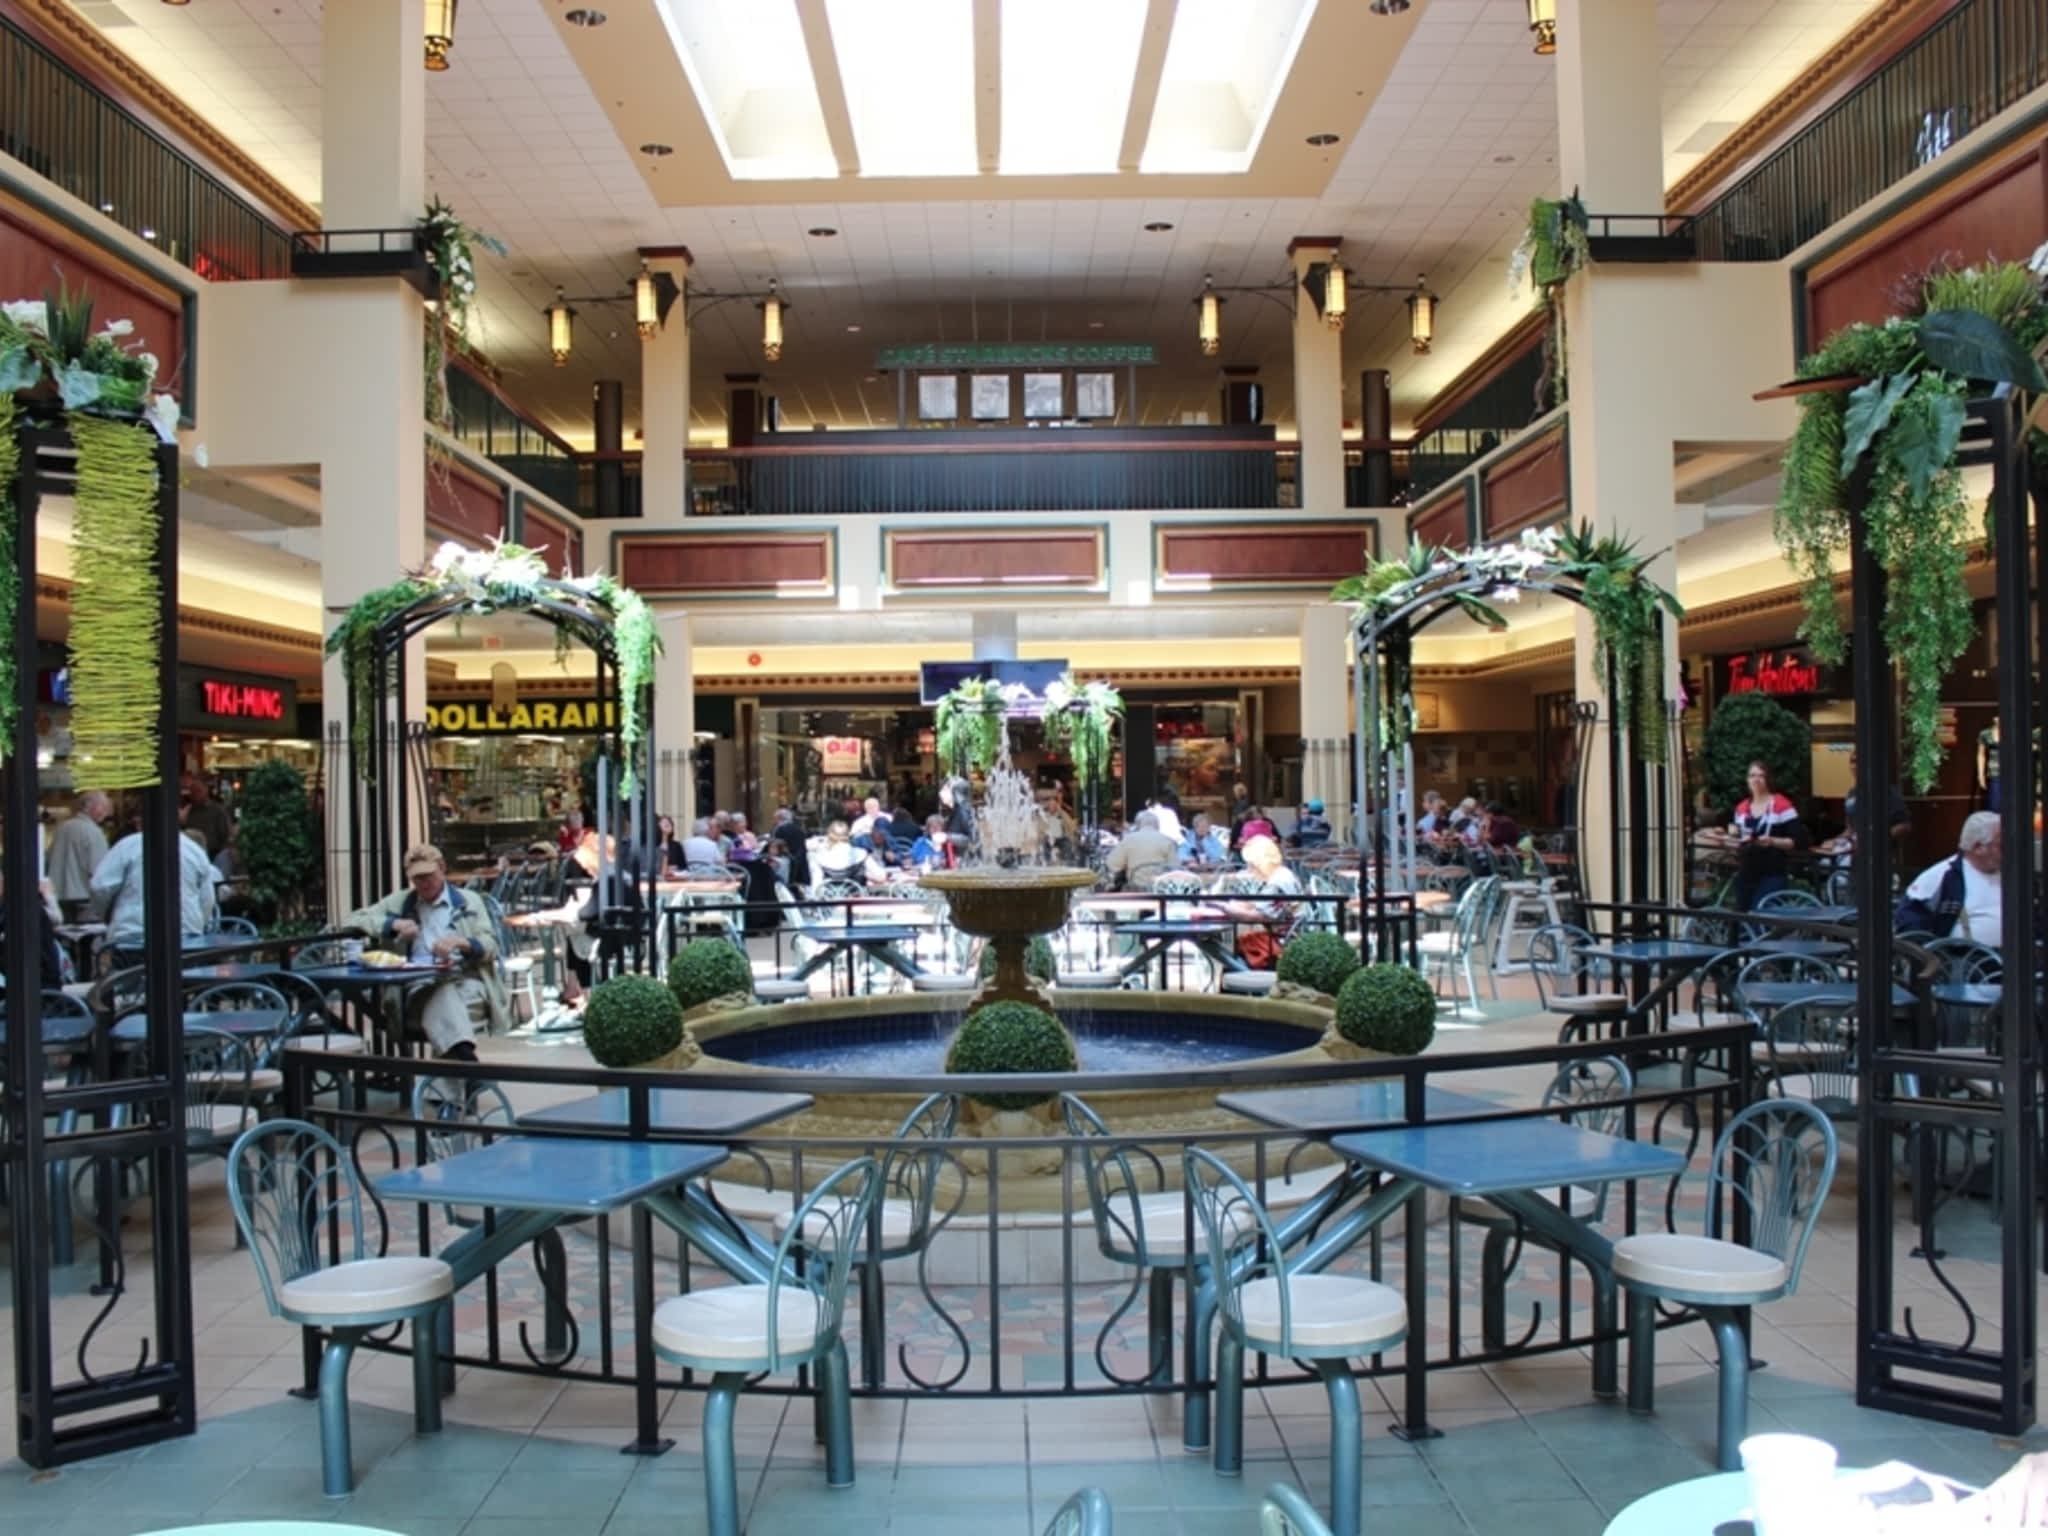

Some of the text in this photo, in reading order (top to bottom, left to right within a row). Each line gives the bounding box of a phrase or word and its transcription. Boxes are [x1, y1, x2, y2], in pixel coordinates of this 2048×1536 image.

[1072, 345, 1152, 361] COFFEE
[1757, 652, 1817, 693] Hortons
[203, 682, 283, 719] TIKI-MING
[426, 702, 620, 731] DOLLARAM
